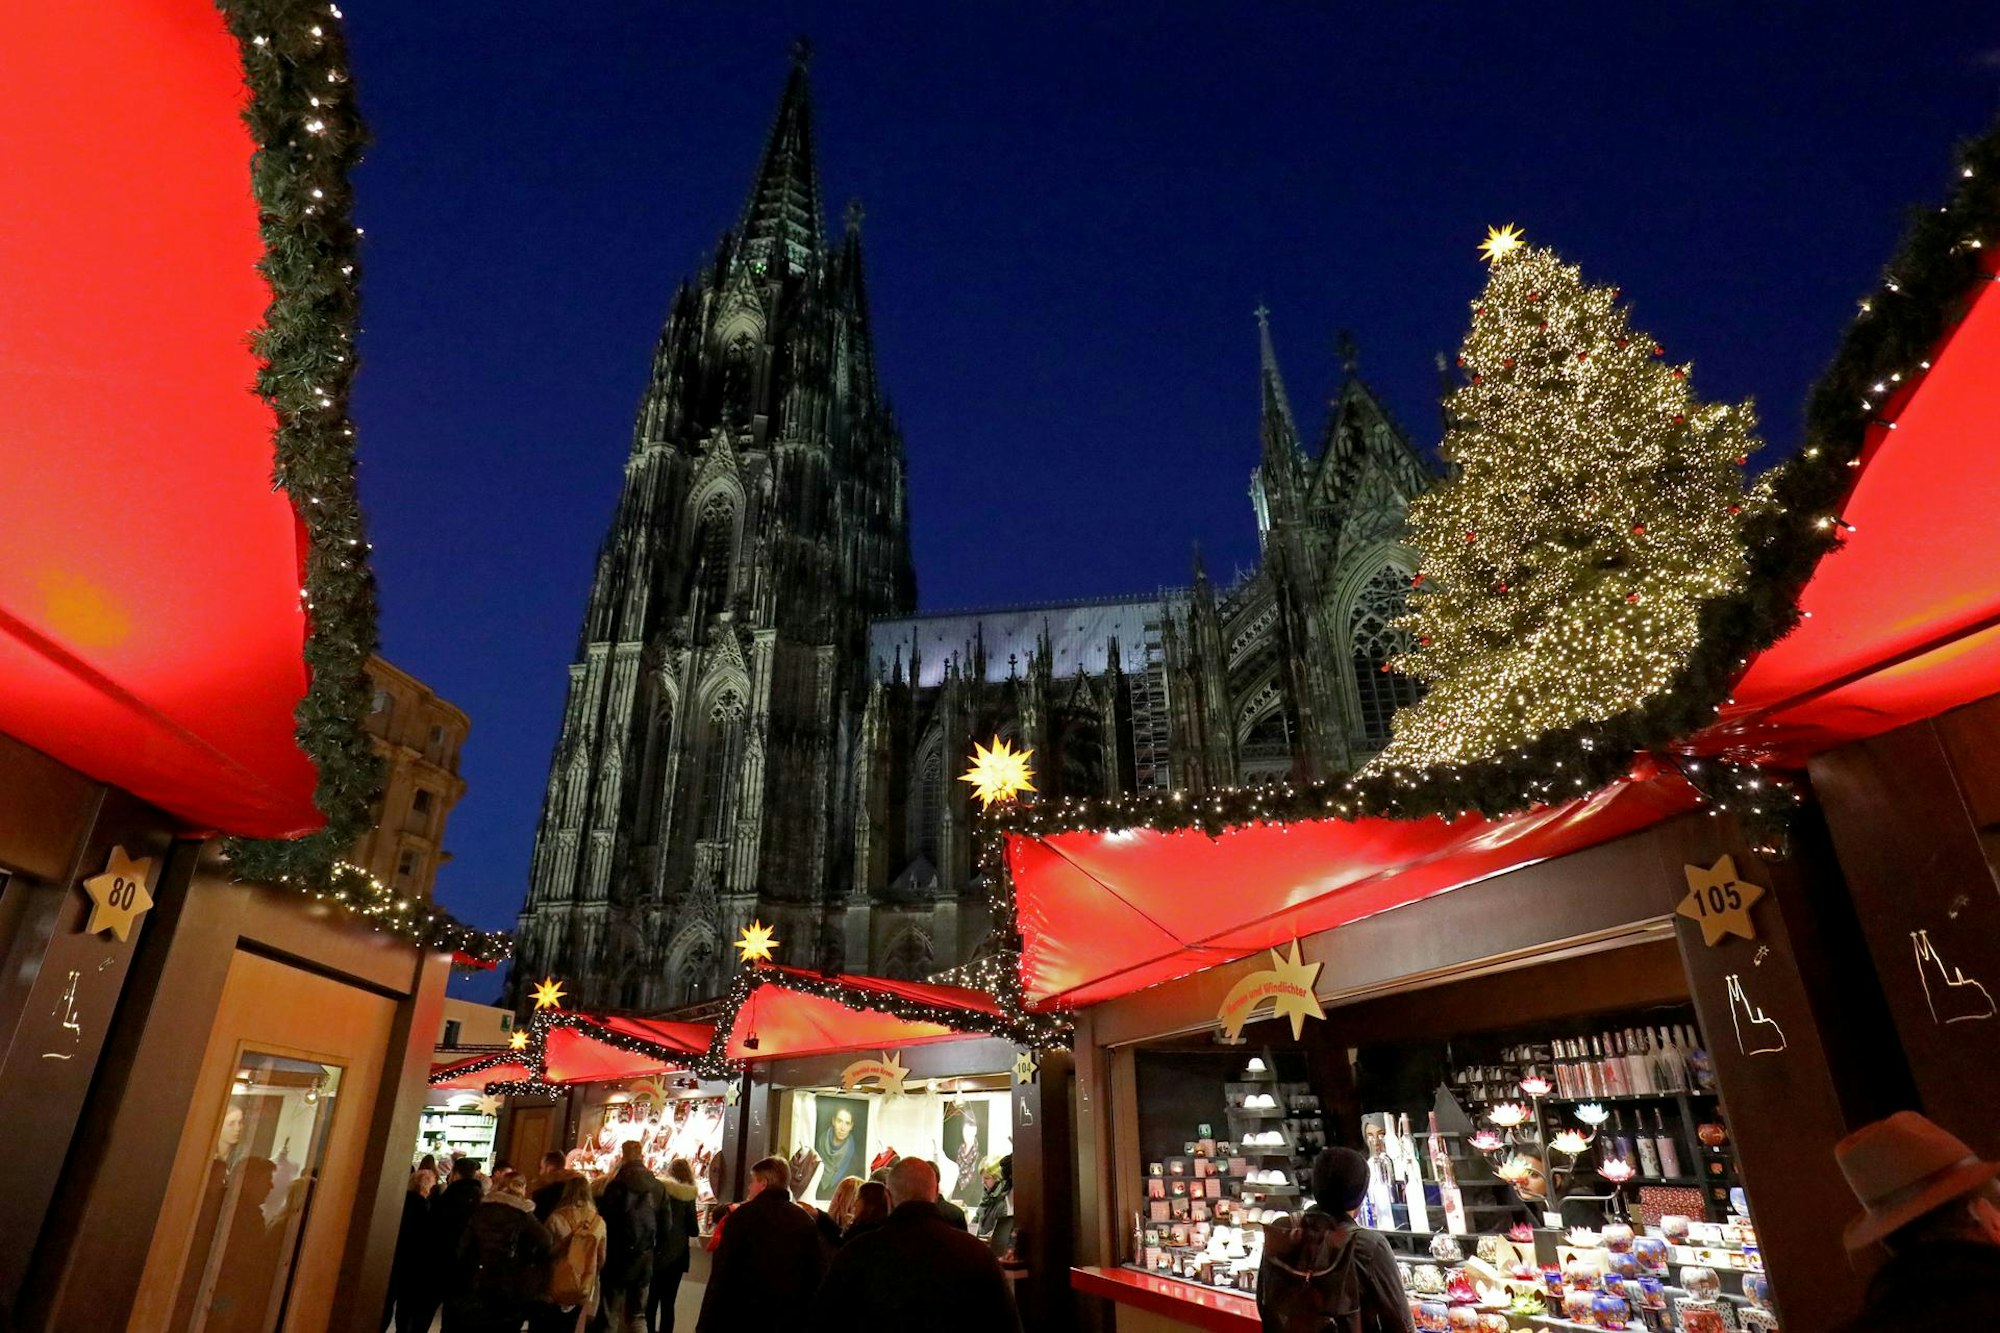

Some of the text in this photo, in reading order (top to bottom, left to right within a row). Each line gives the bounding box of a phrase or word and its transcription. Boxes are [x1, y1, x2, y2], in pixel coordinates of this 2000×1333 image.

[108, 877, 136, 911] 80
[1693, 881, 1741, 917] 105
[1263, 981, 1307, 998] Windlichter
[1018, 1062, 1031, 1073] 104
